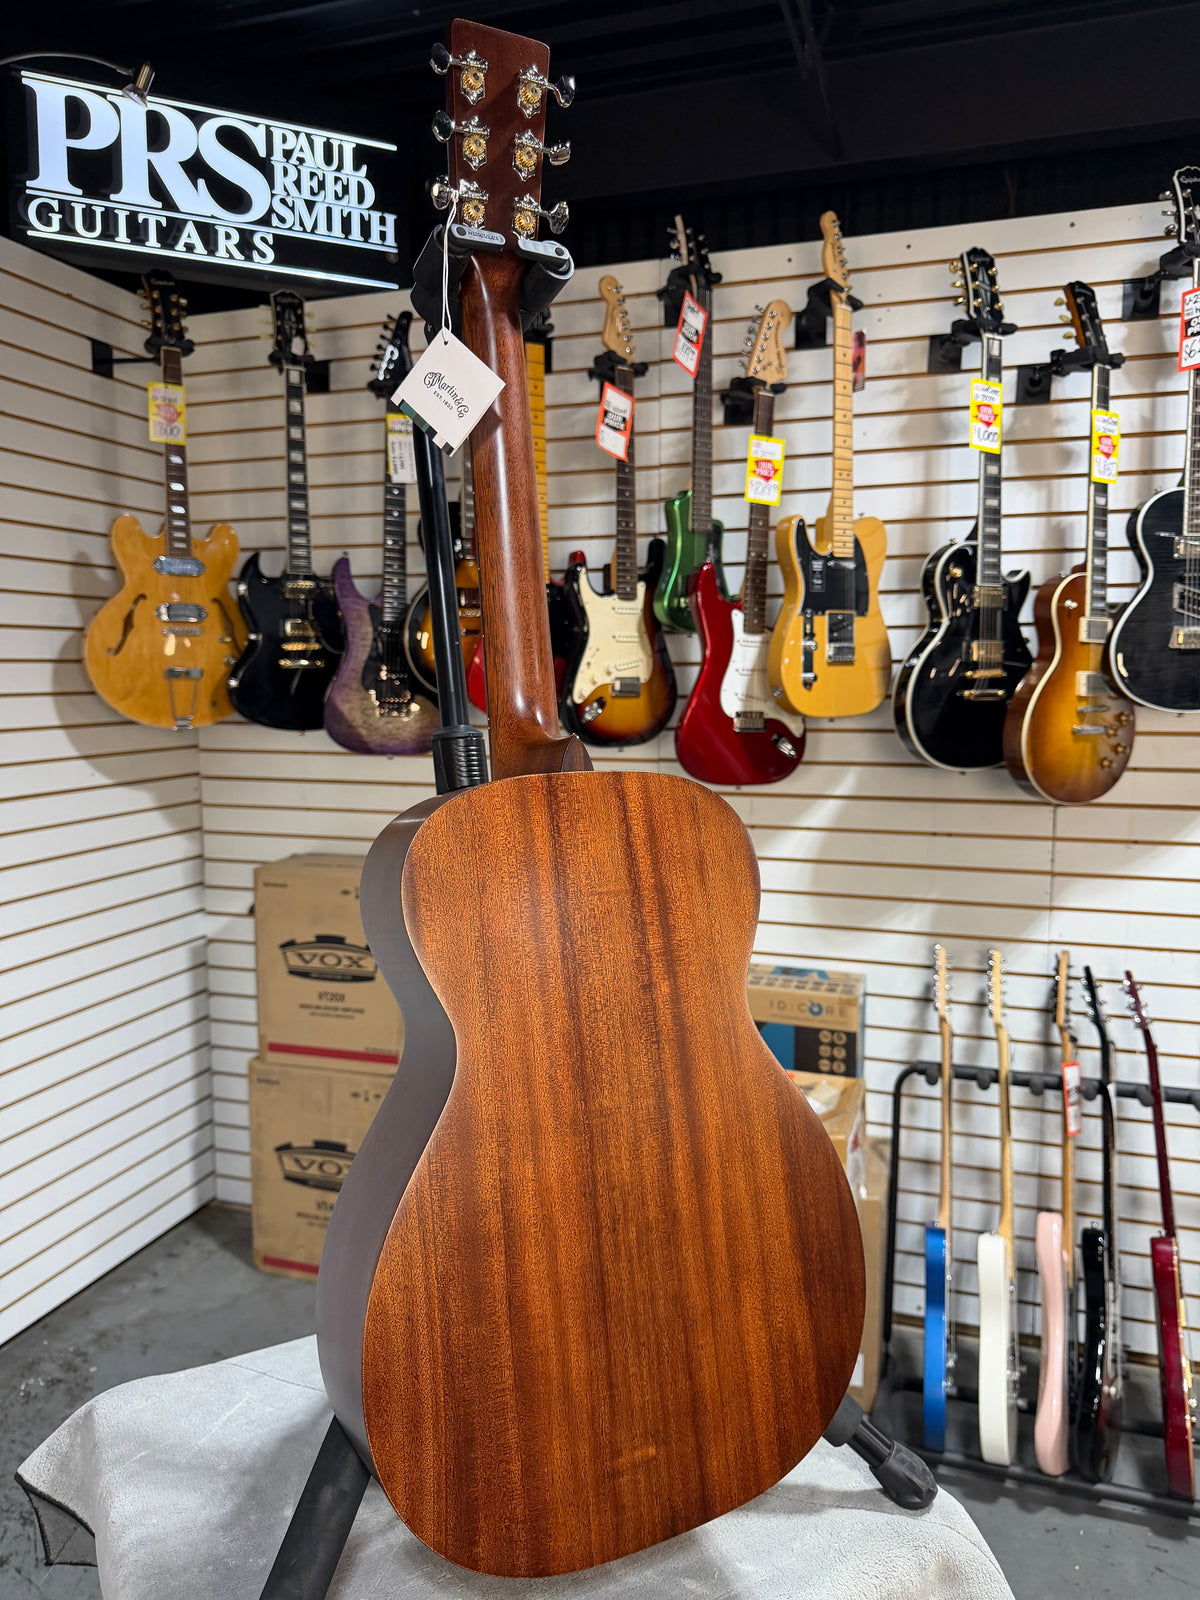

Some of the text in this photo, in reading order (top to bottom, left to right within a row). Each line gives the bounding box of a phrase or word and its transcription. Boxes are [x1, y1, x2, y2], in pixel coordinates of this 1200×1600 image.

[21, 76, 272, 223] PRS
[269, 127, 367, 178] PAUL
[271, 160, 376, 210] REED
[27, 198, 275, 264] GUITARS
[271, 195, 398, 246] SMITH
[293, 952, 369, 969] VOX
[796, 999, 848, 1017] CORE
[293, 1156, 351, 1177] VO
